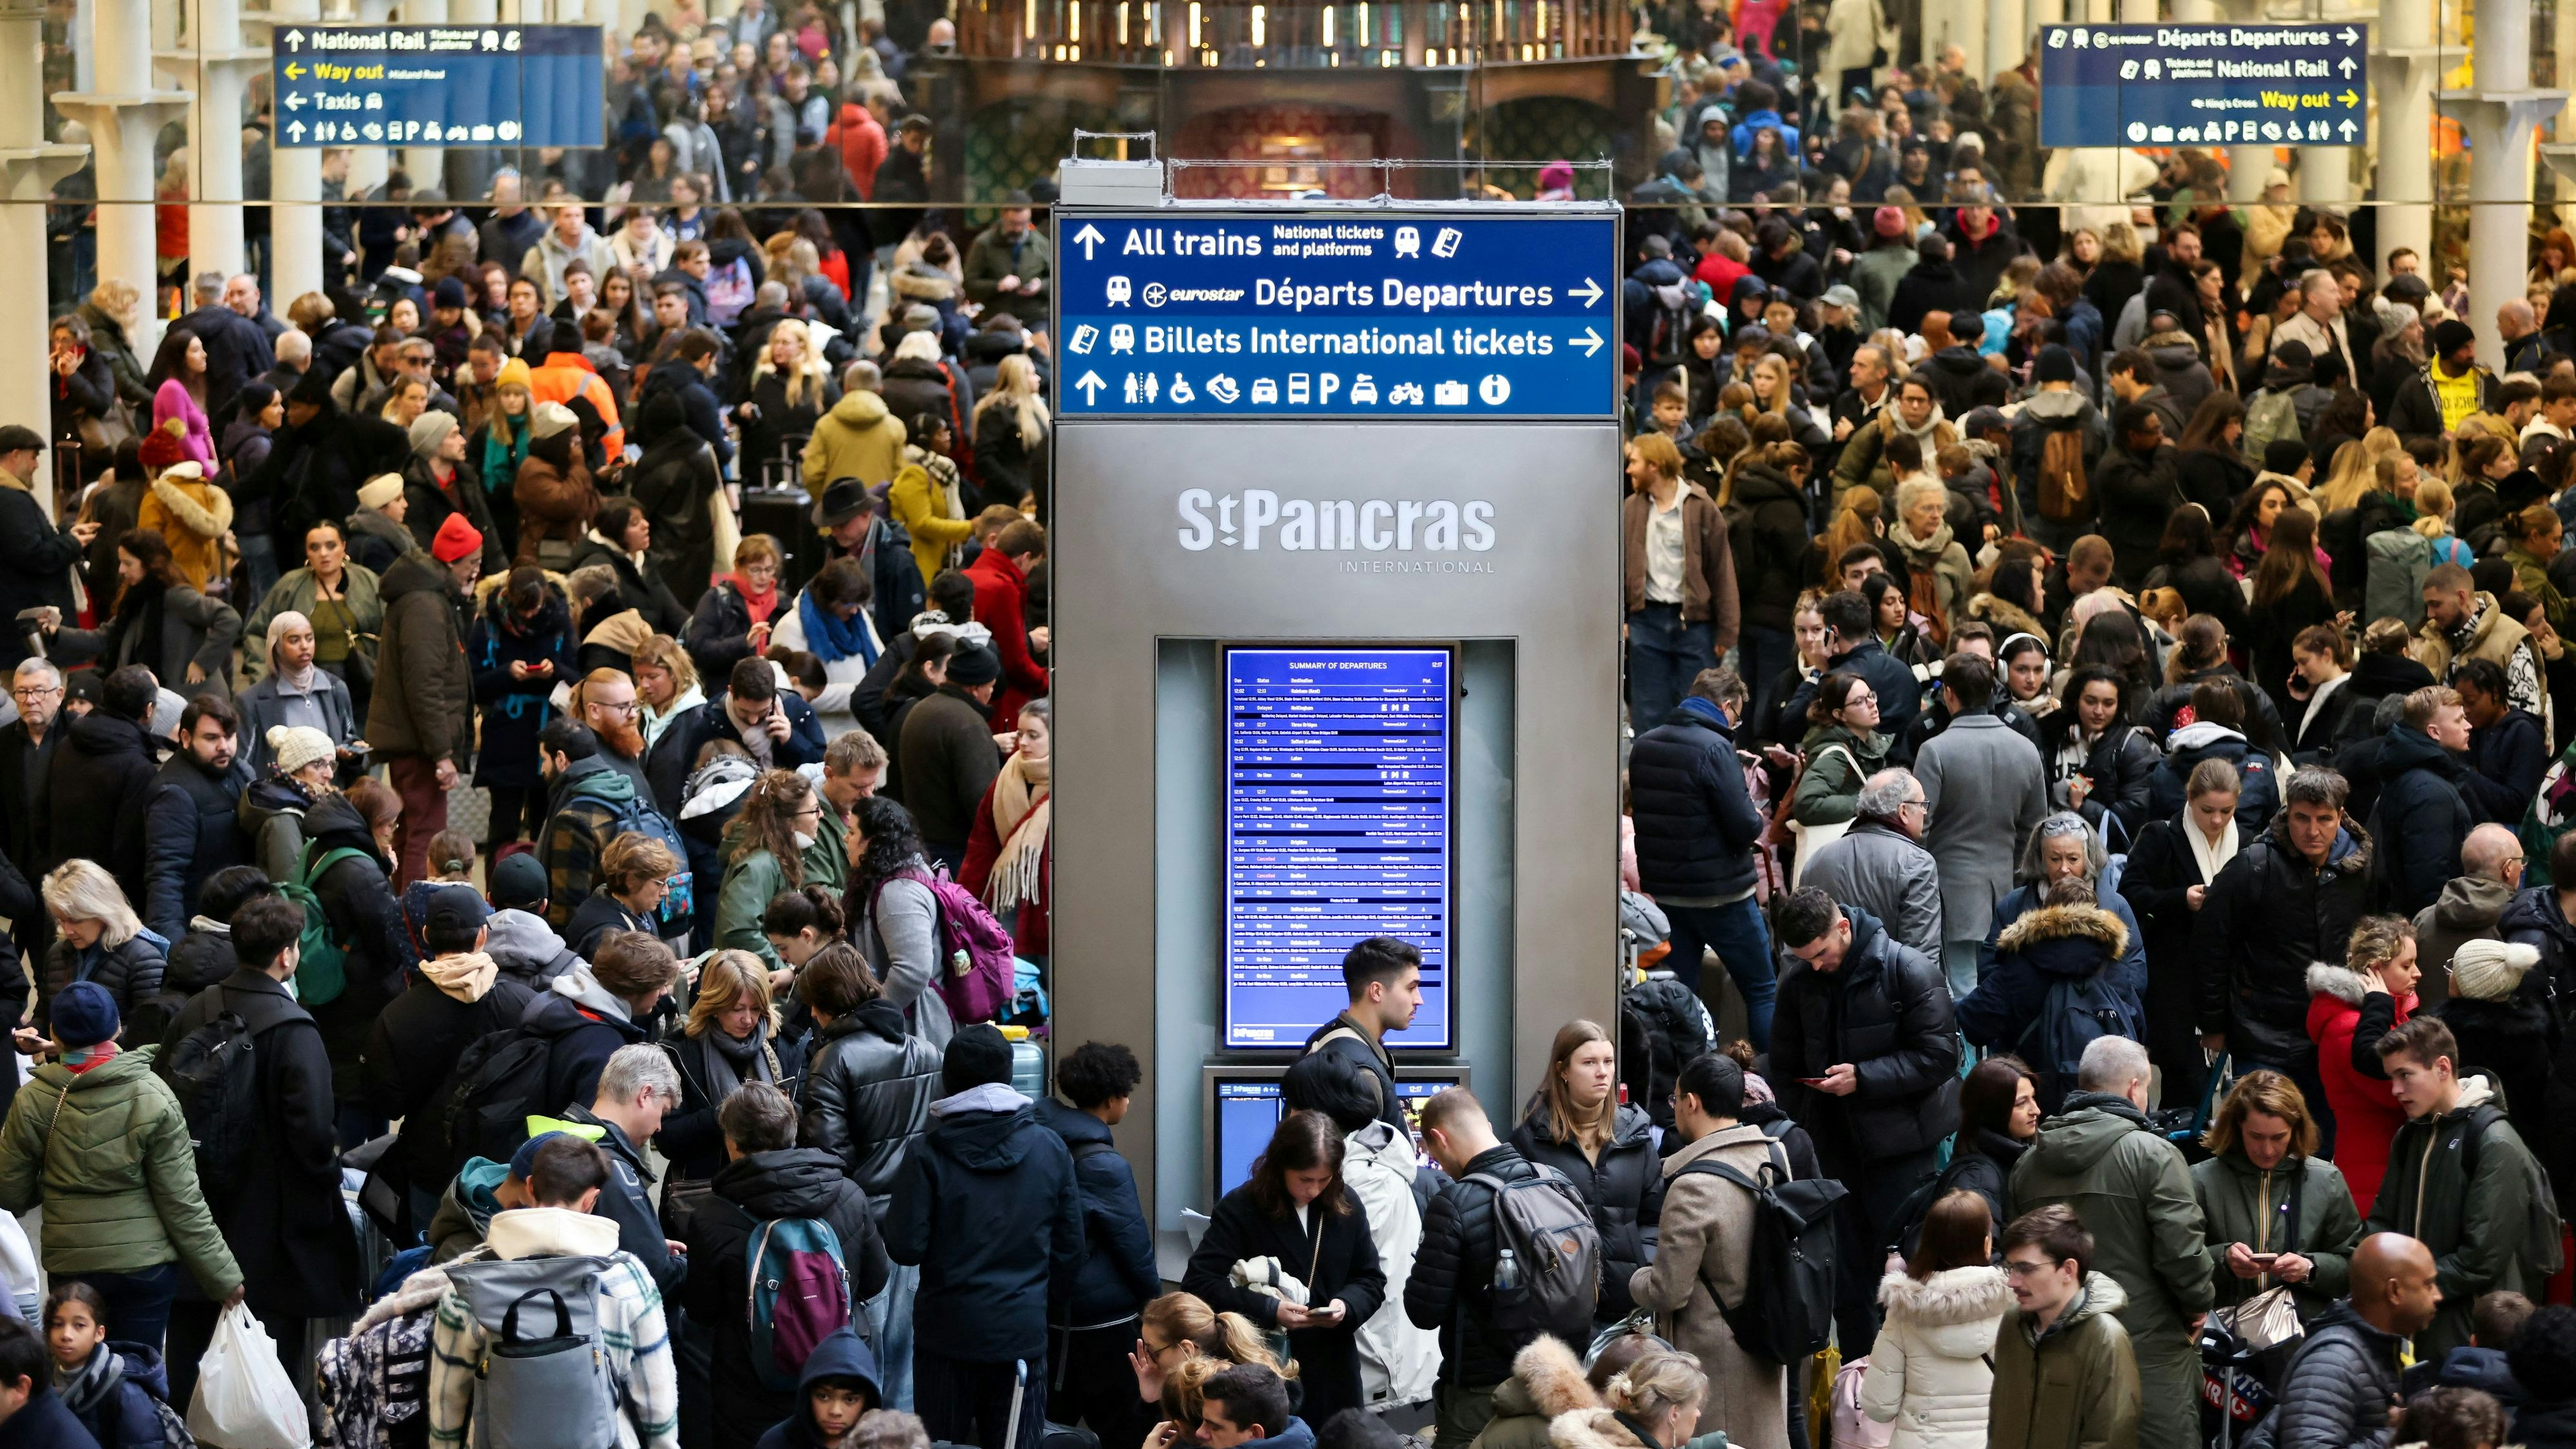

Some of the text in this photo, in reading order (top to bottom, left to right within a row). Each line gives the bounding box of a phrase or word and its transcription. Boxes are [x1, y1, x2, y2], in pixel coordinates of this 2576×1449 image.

[312, 31, 426, 50] National Rail
[460, 30, 478, 40] and
[2157, 28, 2228, 50] Départs
[2231, 28, 2331, 49] Departures
[429, 39, 473, 52] platforms
[2196, 58, 2213, 68] and
[2217, 59, 2330, 78] National Rail
[314, 63, 384, 83] Way out
[2171, 69, 2214, 79] platforms
[314, 92, 361, 109] Taxis
[2260, 90, 2331, 111] Way out
[1274, 225, 1383, 239] National tickets
[1124, 229, 1261, 255] All trains
[1274, 242, 1372, 258] and platforms
[1170, 278, 1553, 313] eurostar Départs Departures
[1146, 327, 1553, 355] Billets International tickets
[1244, 489, 1496, 552] Pancras
[1340, 561, 1495, 573] INTERNATIONAL
